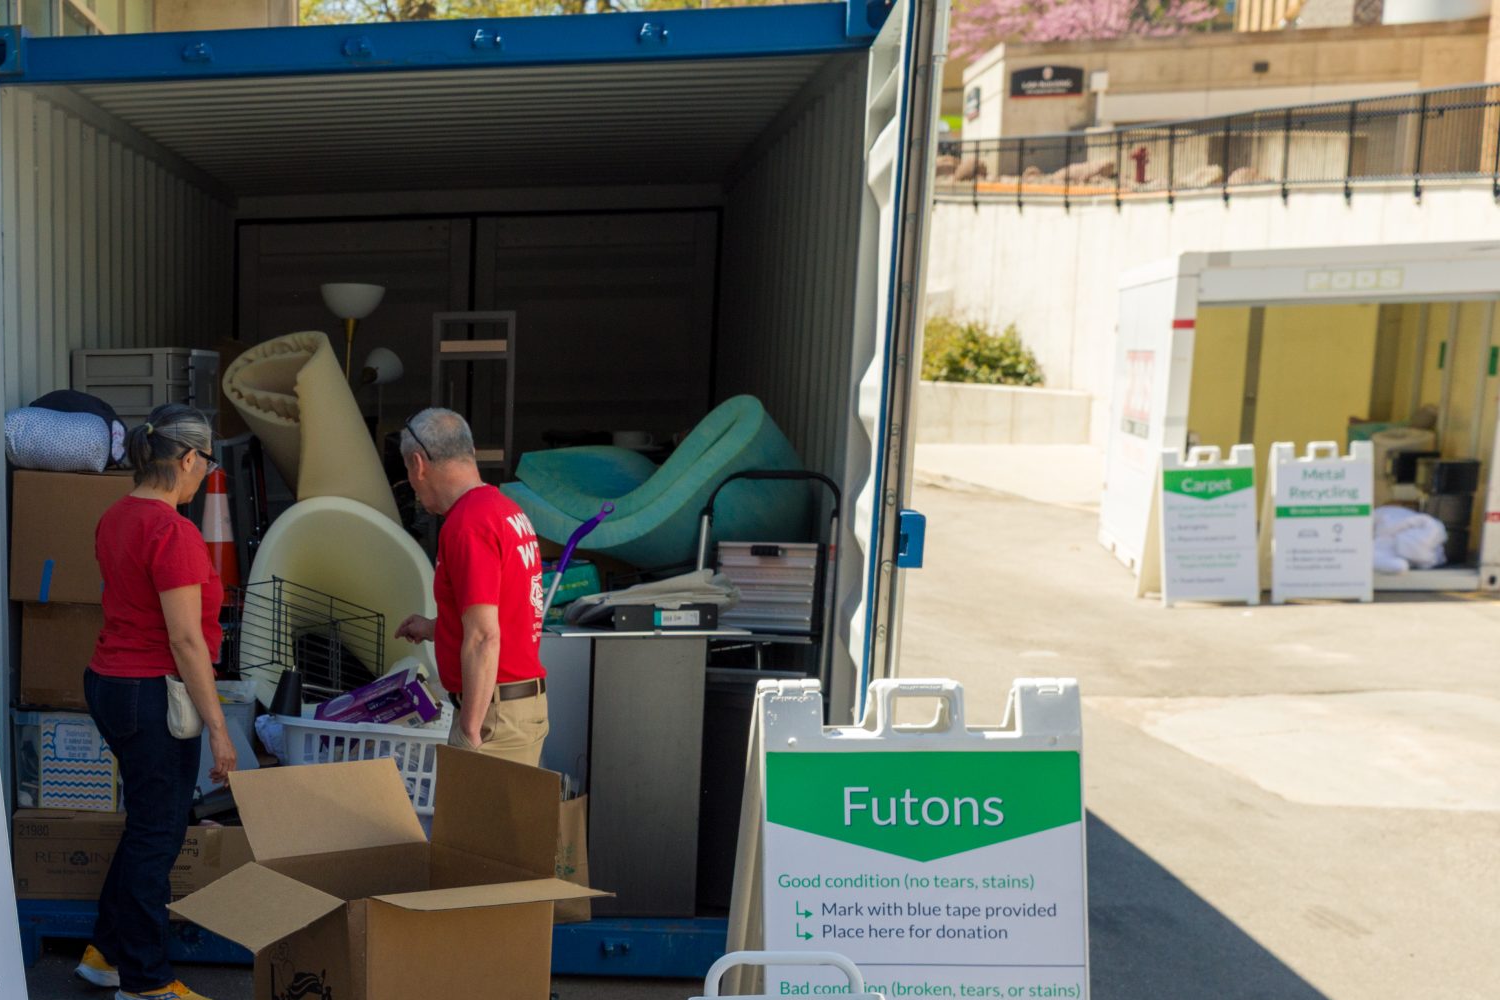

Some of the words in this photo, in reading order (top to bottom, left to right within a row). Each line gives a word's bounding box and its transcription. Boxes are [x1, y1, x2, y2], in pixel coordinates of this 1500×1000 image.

[1181, 477, 1233, 494] Carpet
[1289, 486, 1359, 500] Recycling
[843, 785, 1005, 827] Futons
[778, 874, 821, 889] Good
[825, 873, 900, 889] condition
[904, 873, 929, 891] (no
[934, 875, 979, 891] tears,
[982, 873, 1035, 891] stains)
[821, 902, 864, 917] Mark
[868, 902, 903, 917] with
[907, 902, 941, 918] blue
[945, 904, 981, 922] tape
[985, 903, 1057, 922] provided
[822, 924, 864, 939] Place
[868, 924, 905, 939] here
[909, 924, 933, 939] for
[936, 925, 1008, 940] donation
[780, 981, 809, 995] Bad
[891, 981, 956, 998] (broken,
[960, 983, 1004, 998] tears,
[1008, 985, 1025, 997] or
[1029, 983, 1081, 999] stains)
